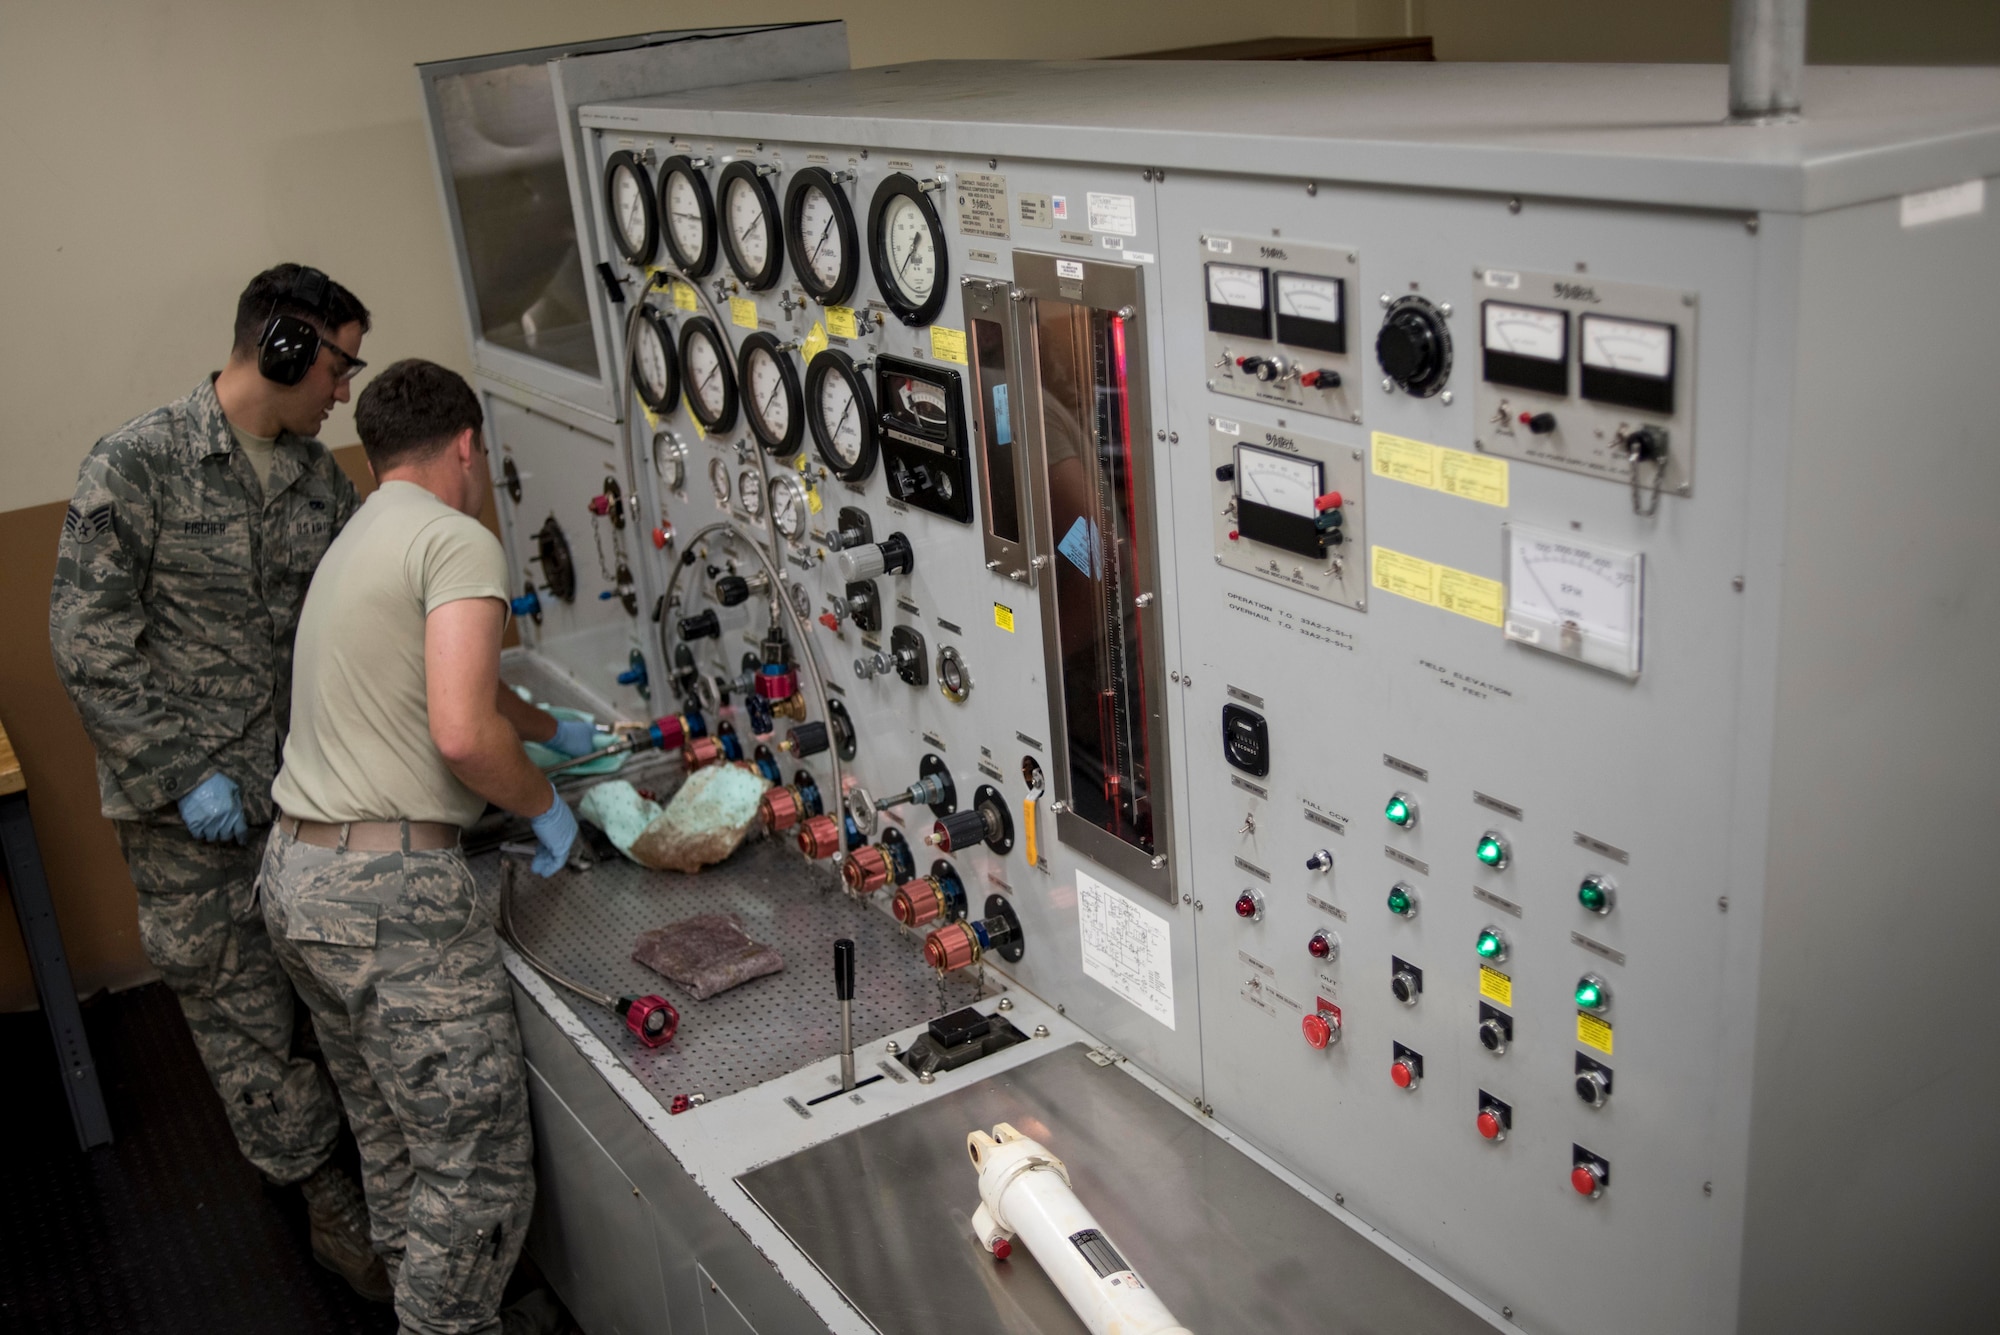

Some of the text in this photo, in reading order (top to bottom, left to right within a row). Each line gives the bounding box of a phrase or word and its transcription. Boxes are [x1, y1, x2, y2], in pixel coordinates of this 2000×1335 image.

[184, 521, 226, 535] FISCHER
[1227, 592, 1273, 612] OPERATION
[1279, 610, 1295, 619] T.O.
[1229, 603, 1271, 622] OVERHAUL
[1278, 621, 1294, 630] T.O.
[1419, 659, 1512, 697] FIELD ELEVATION
[1462, 686, 1488, 699] FEET
[1234, 742, 1257, 755] SECONDS
[1303, 798, 1349, 823] FULL CCW
[1320, 974, 1337, 986] OUT
